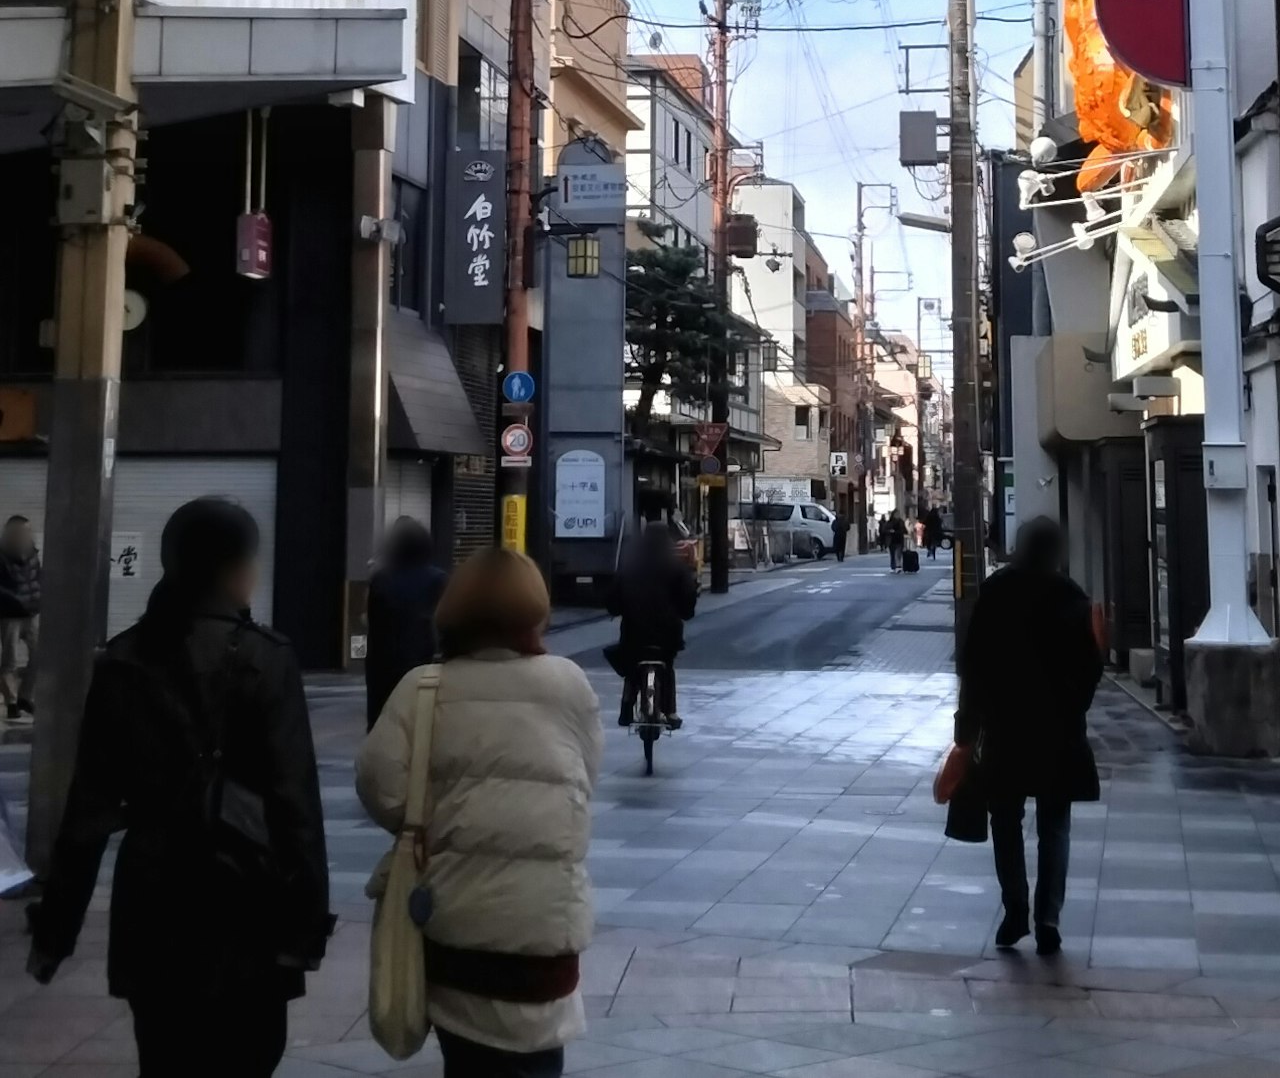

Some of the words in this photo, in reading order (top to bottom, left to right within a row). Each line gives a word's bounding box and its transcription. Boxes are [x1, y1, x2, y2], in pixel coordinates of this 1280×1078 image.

[463, 193, 495, 286] 白竹堂
[510, 433, 525, 448] 20
[835, 455, 843, 464] P
